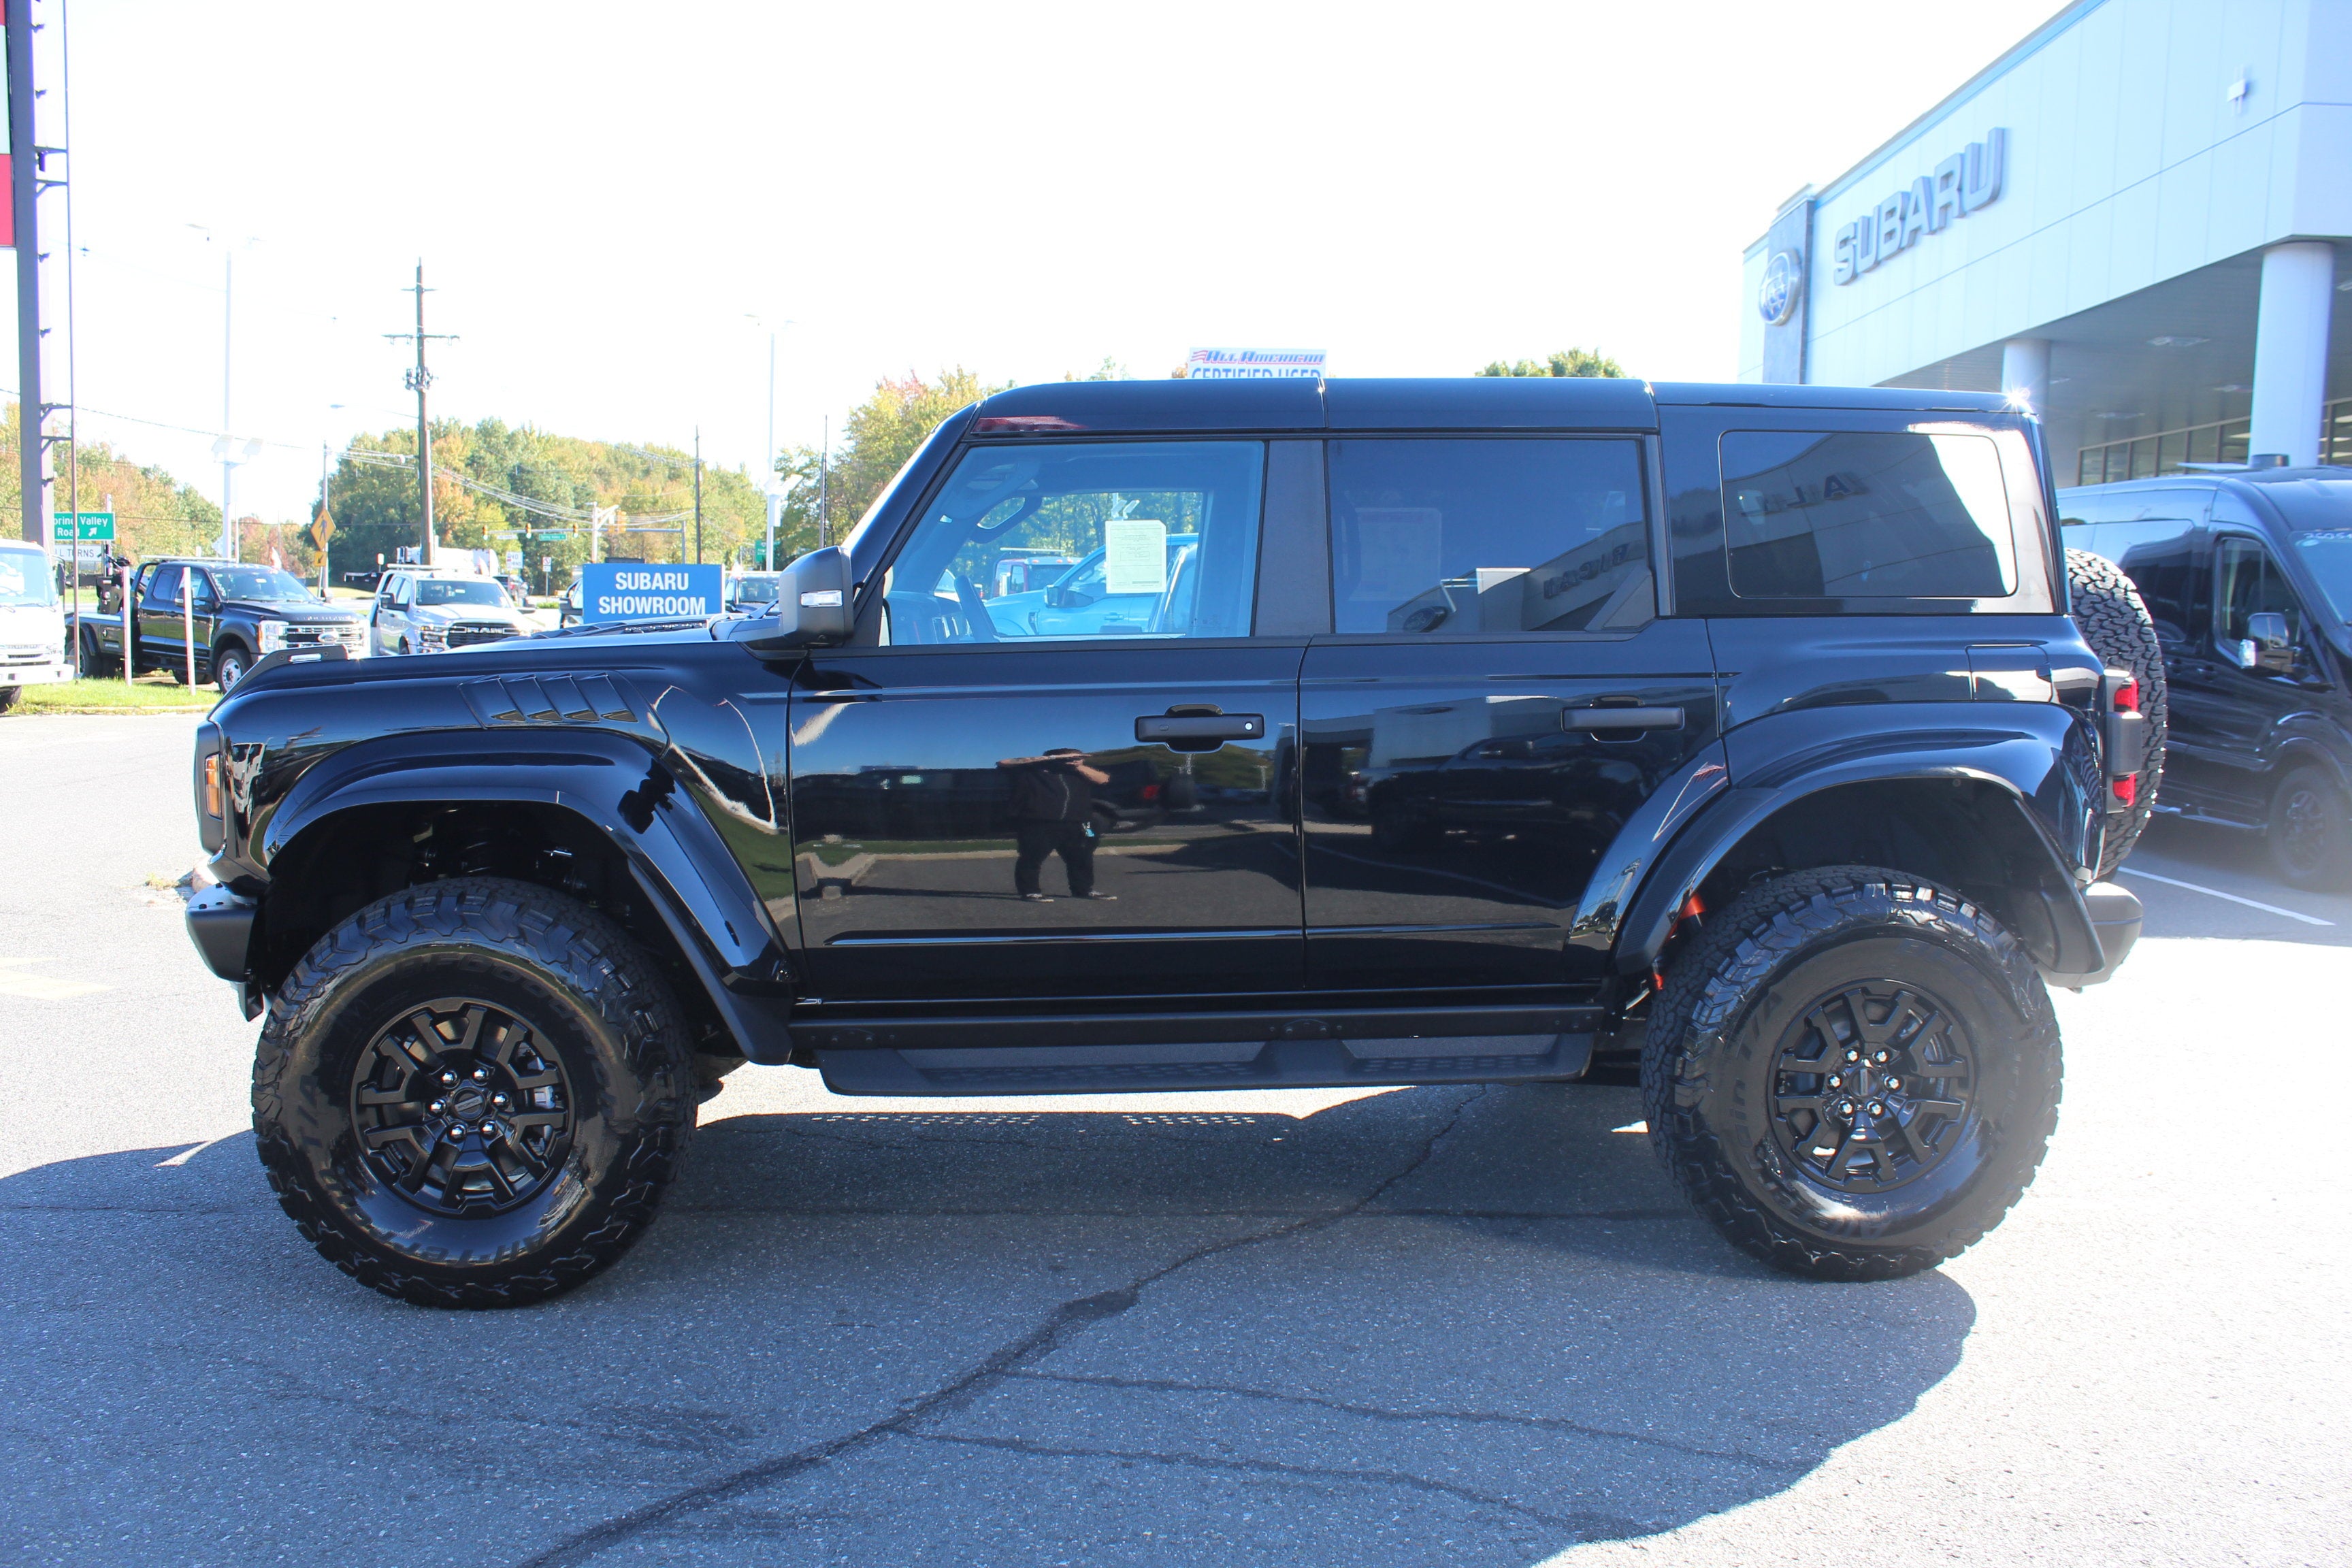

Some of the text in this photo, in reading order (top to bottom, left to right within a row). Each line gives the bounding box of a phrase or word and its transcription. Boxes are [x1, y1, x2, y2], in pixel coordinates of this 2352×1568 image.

[1833, 127, 2009, 286] SUBARU
[80, 516, 108, 527] Valley
[67, 549, 95, 558] TRNS
[615, 572, 689, 591] SUBARU
[599, 596, 706, 615] SHOWROOM
